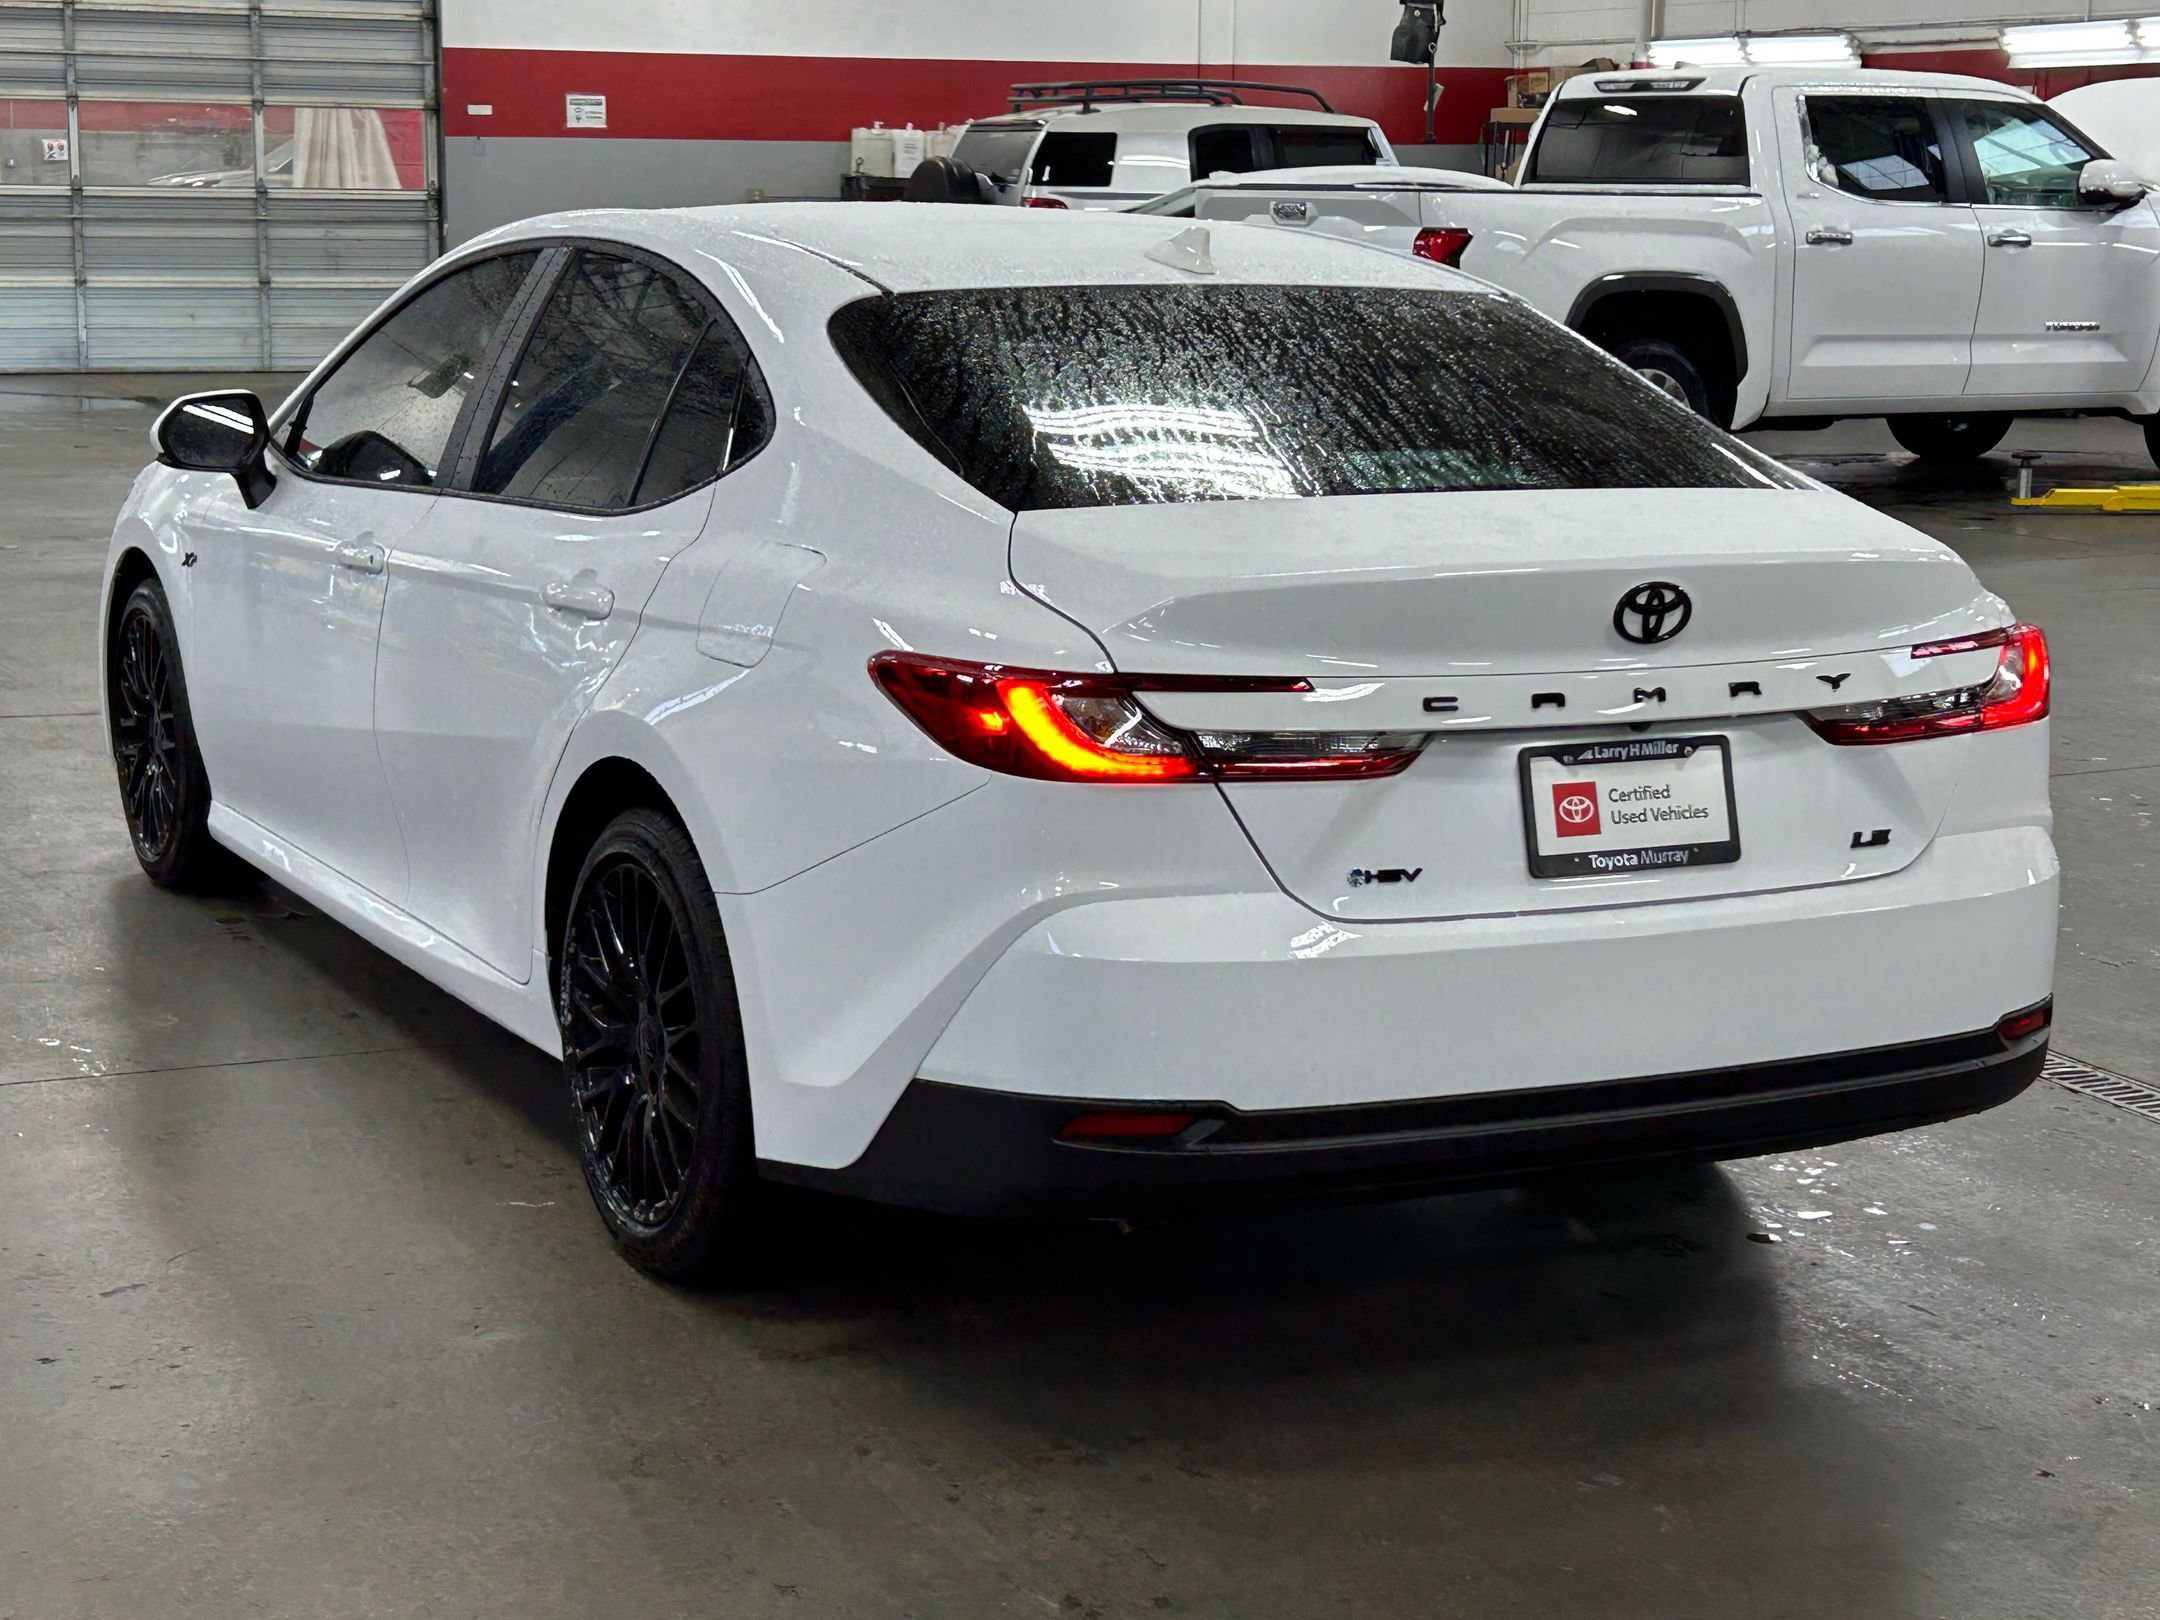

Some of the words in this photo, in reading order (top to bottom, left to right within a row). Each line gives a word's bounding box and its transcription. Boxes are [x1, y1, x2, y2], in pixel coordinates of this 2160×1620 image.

[1422, 672, 1851, 713] CAMRY
[1594, 746, 1628, 760] Larry
[1630, 744, 1640, 757] H
[1641, 741, 1679, 756] Miller
[1609, 785, 1671, 803] Certified
[1612, 808, 1647, 824] Used
[1651, 804, 1709, 821] Vehicles
[1589, 853, 1638, 870] Toyota
[1640, 850, 1689, 866] Murray
